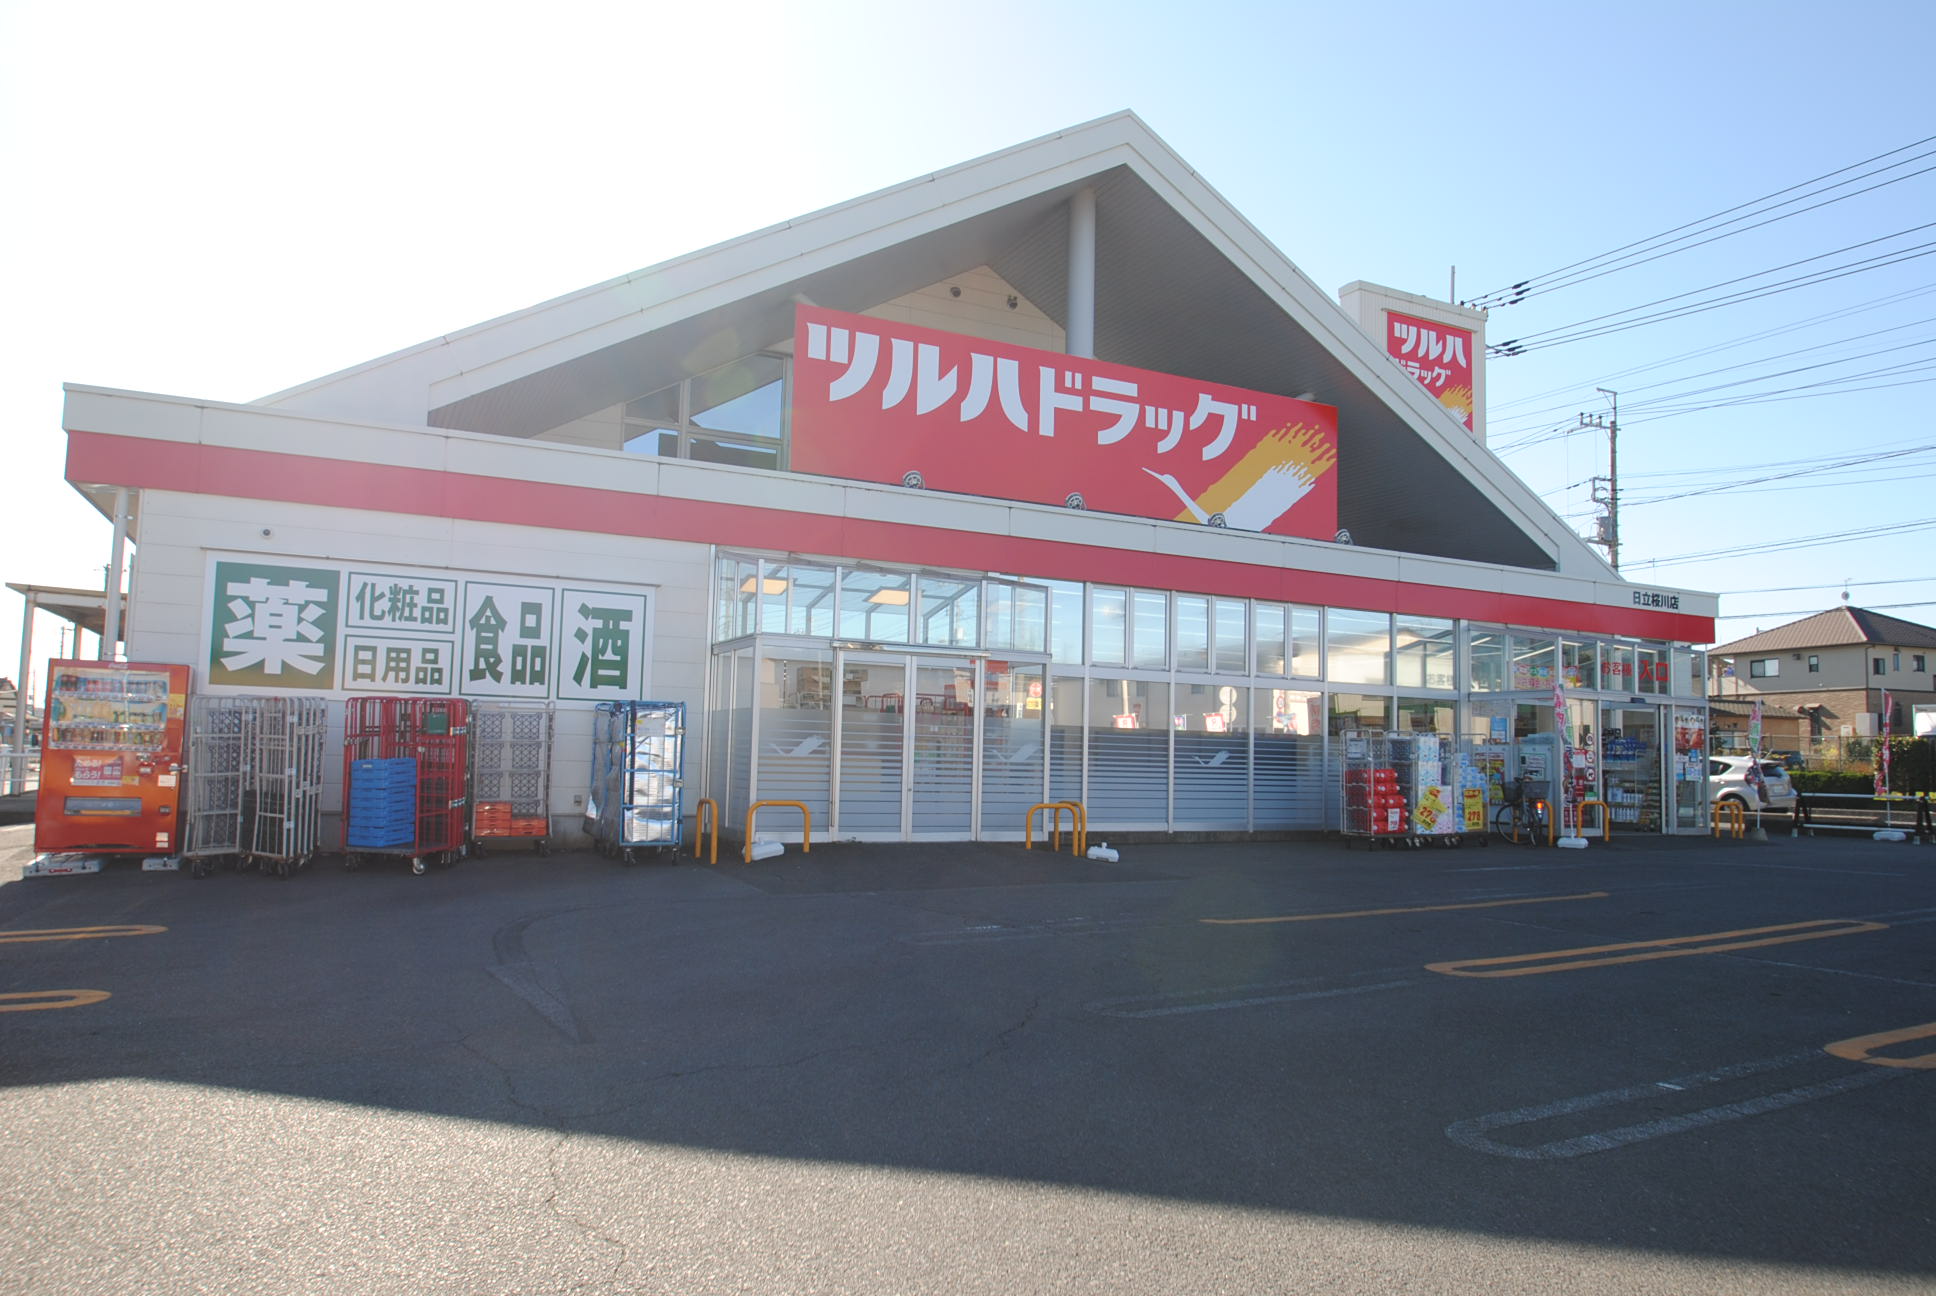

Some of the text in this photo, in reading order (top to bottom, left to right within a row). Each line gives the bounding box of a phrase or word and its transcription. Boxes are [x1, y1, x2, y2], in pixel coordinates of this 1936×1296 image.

[1394, 322, 1467, 368] ツルハ
[807, 322, 1256, 460] ツルハドラッグ
[355, 580, 450, 626] 化粧品
[1633, 591, 1679, 609] 日立桜川店
[219, 576, 328, 675] 薬
[468, 594, 548, 687] 食品
[572, 601, 634, 690] 酒
[351, 643, 443, 686] 日用品
[1640, 660, 1670, 681] 入口
